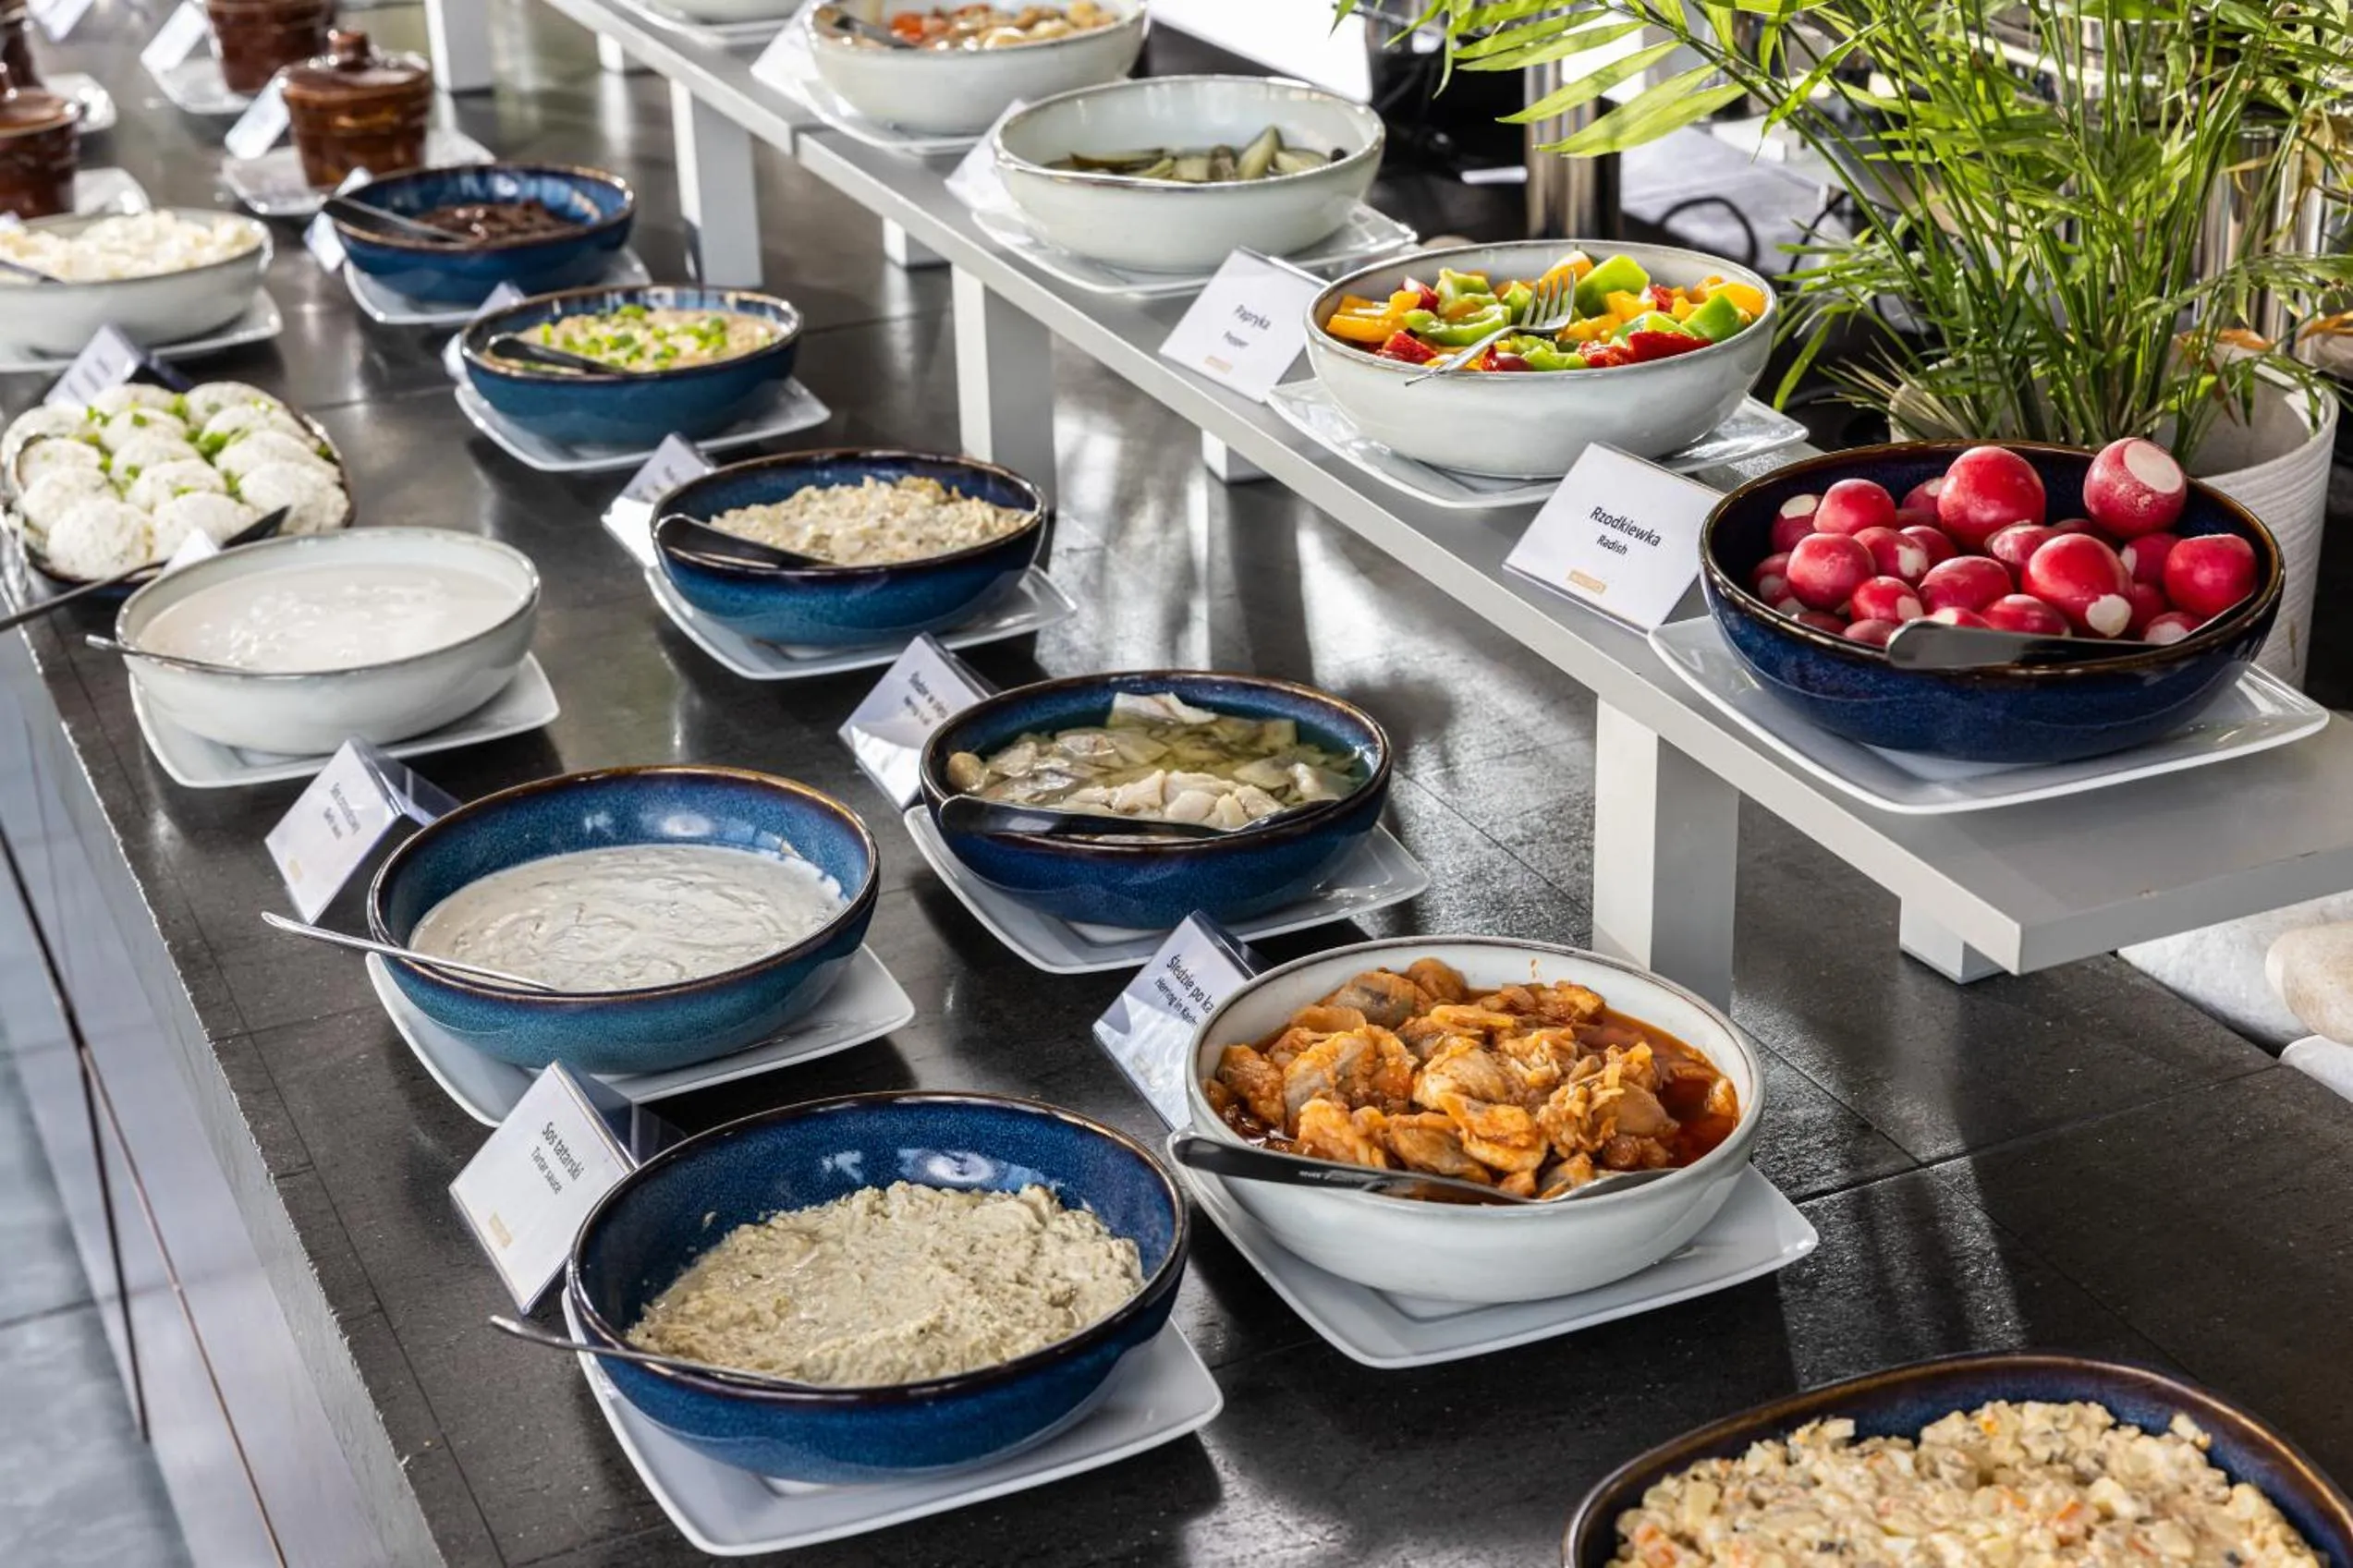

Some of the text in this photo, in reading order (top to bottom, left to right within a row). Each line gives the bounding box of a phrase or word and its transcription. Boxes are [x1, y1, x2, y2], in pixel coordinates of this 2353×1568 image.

[1590, 506, 1662, 547] Rzodkiewka
[1597, 535, 1628, 555] Radish
[1166, 954, 1195, 991] Śledzie
[1189, 987, 1204, 1003] po
[531, 1146, 563, 1194] Tartar sauce
[543, 1122, 584, 1181] Sos tatarski
